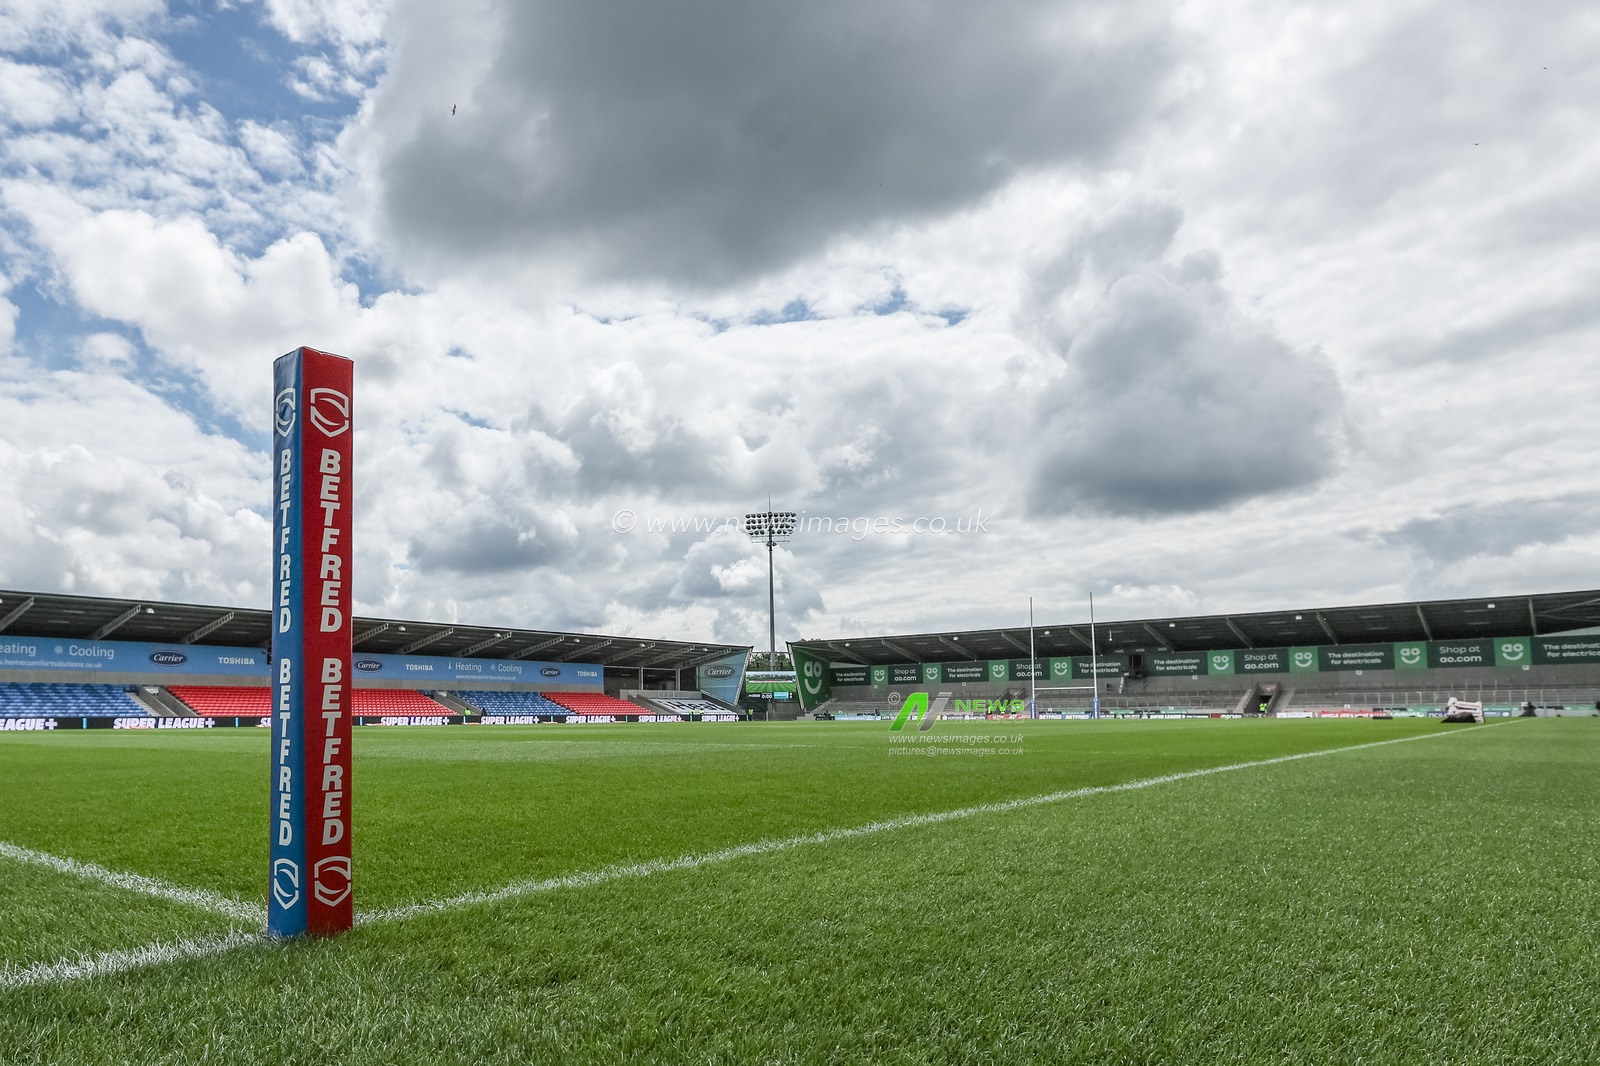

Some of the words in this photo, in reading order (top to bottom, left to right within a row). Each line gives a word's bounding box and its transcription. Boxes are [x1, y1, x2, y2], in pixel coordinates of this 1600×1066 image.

[279, 449, 291, 634] BETFRED
[319, 448, 342, 633] BETFRED
[1400, 647, 1420, 656] ao
[1439, 646, 1467, 654] Shop
[1468, 645, 1480, 653] at
[1501, 643, 1523, 652] ao
[69, 645, 115, 660] Cooling
[1294, 652, 1312, 660] ao
[153, 653, 184, 662] Carrier
[218, 656, 255, 665] TOSHIBA
[1212, 655, 1229, 663] ao
[1439, 655, 1482, 663] ao.com
[357, 660, 380, 669] Carrier
[455, 662, 482, 673] Heating
[497, 663, 523, 675] Cooling
[803, 660, 822, 678] ao
[992, 664, 1005, 672] ao
[707, 667, 733, 676] Carrier
[113, 717, 156, 729] SUPER
[380, 716, 409, 726] SUPER
[480, 715, 505, 725] SUPER
[565, 715, 586, 724] SUPER
[278, 658, 292, 846] BETFRED
[321, 658, 344, 845] BETFRED
